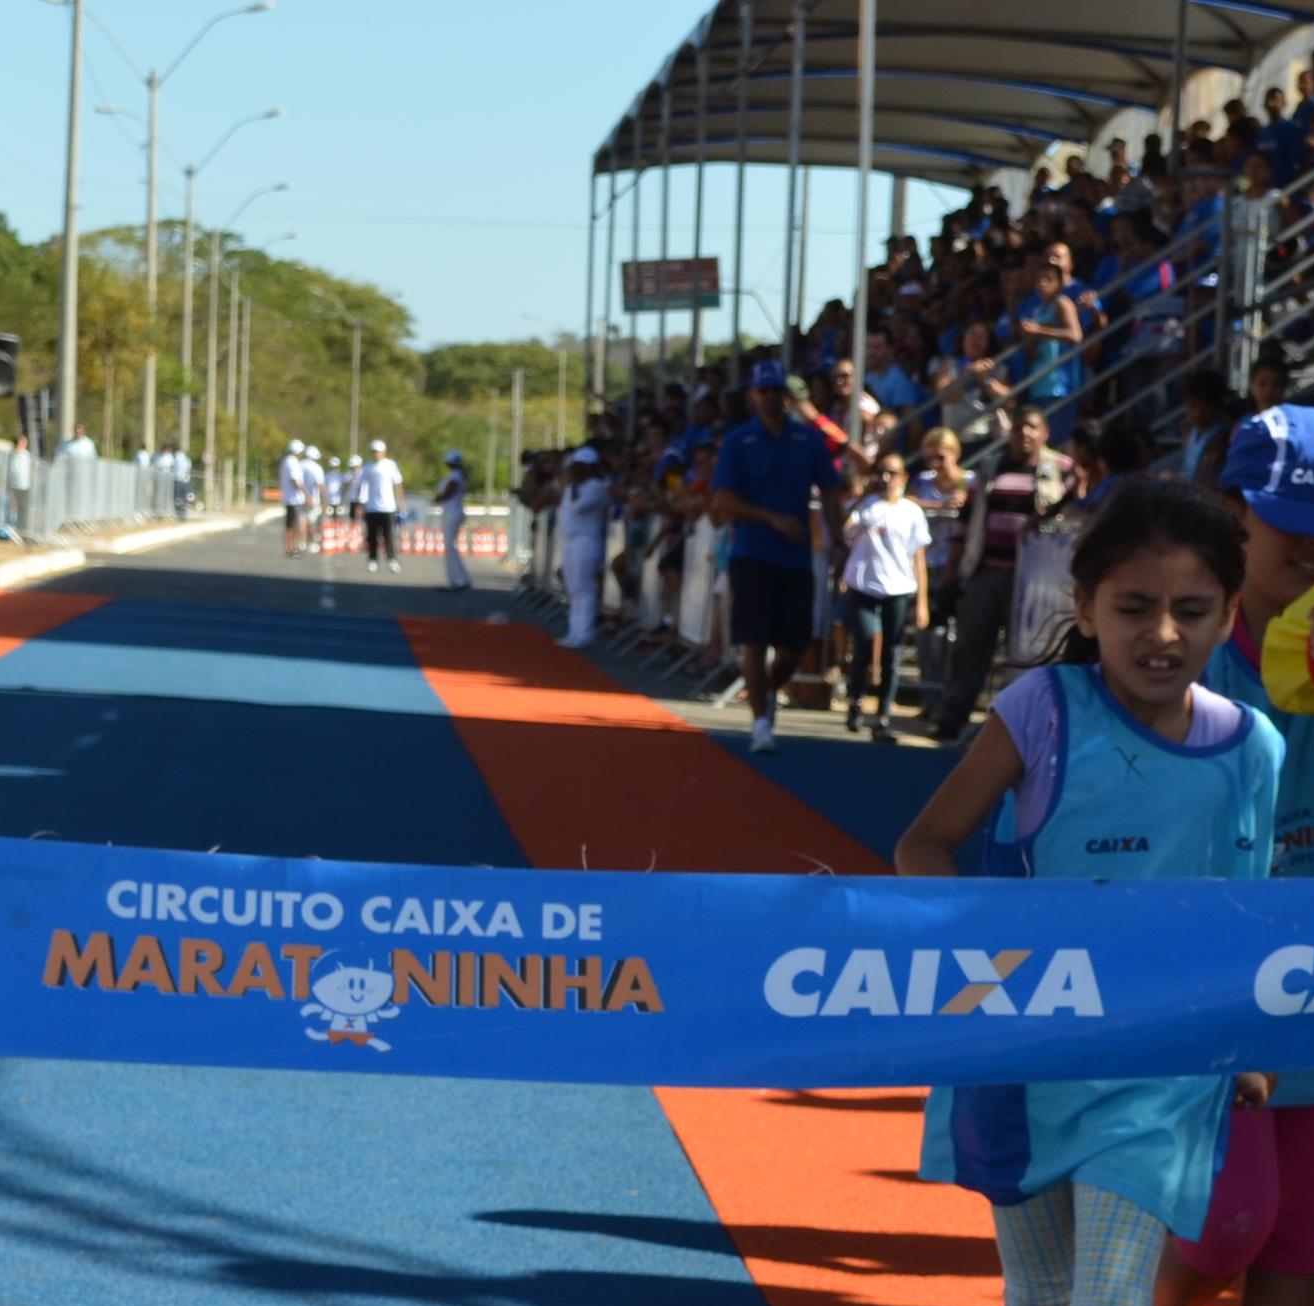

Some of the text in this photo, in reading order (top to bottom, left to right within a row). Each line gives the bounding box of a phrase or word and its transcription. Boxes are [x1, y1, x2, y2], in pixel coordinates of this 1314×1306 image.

[1085, 836, 1149, 855] CAIXA
[106, 880, 603, 941] CIRCUITO CAIXA DE
[763, 947, 1105, 1017] CAIXA
